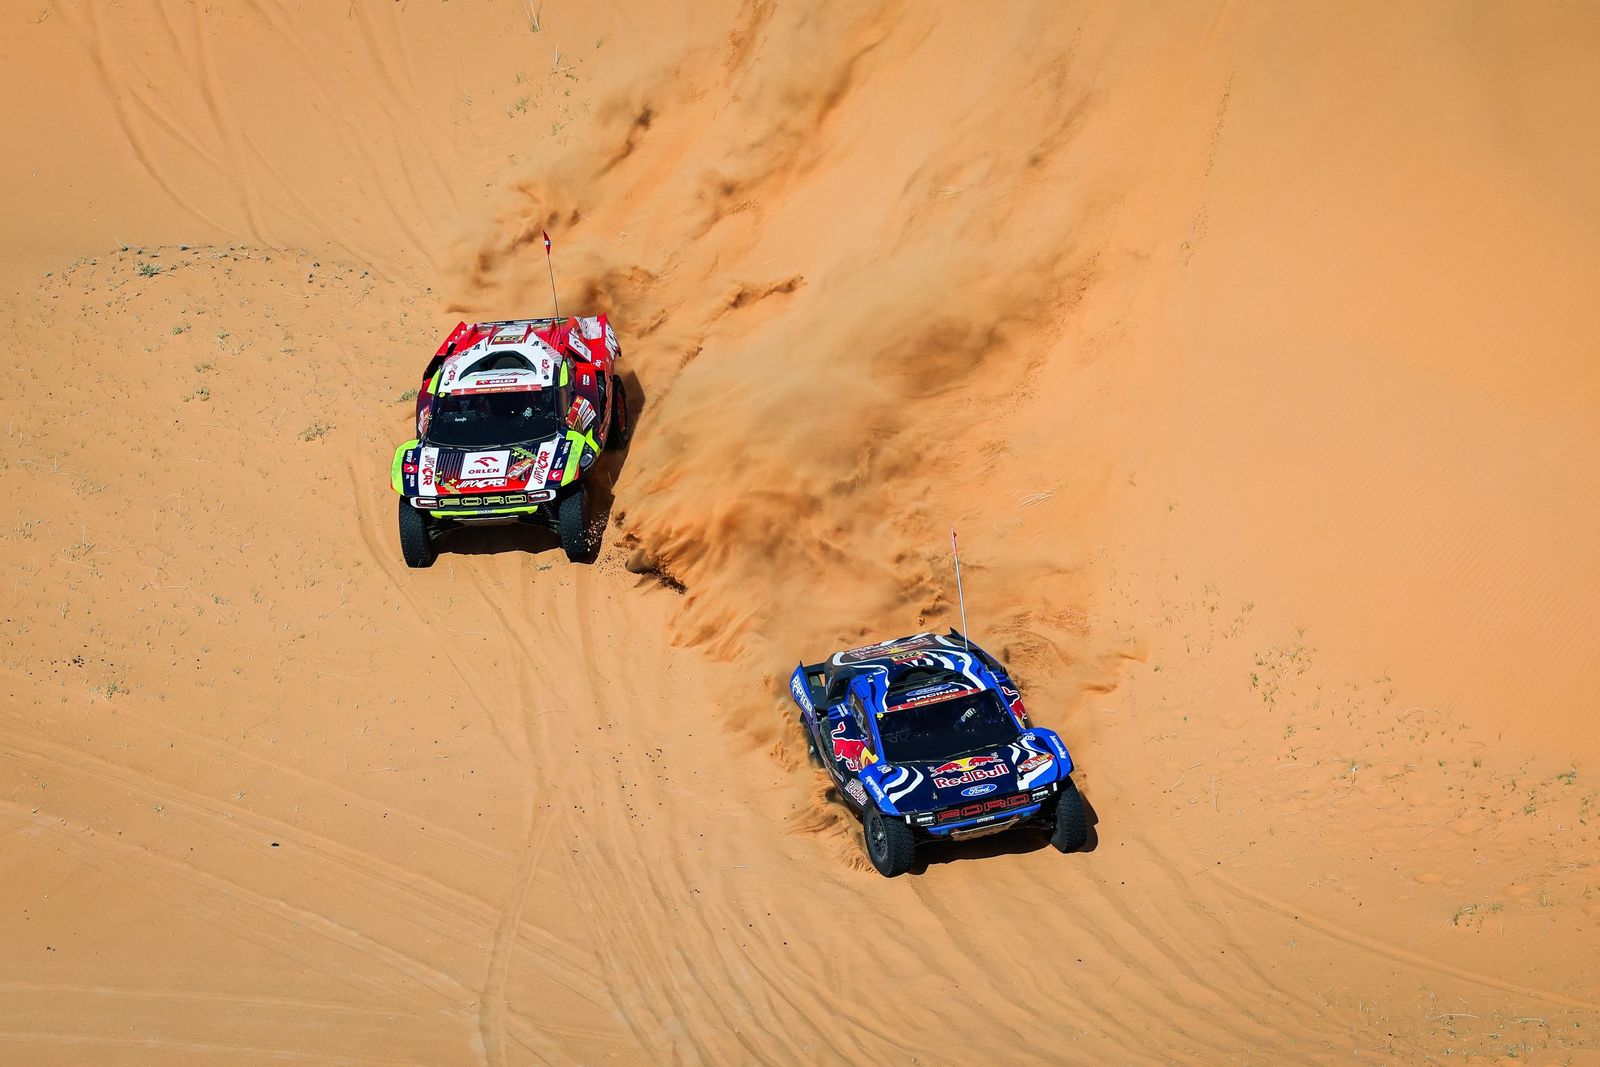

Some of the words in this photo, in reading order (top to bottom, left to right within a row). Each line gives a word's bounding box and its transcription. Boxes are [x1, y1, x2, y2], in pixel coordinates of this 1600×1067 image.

[439, 494, 526, 507] FORD
[934, 772, 973, 789] Red
[972, 763, 1010, 781] Bull
[968, 785, 991, 795] Ford
[937, 793, 1030, 821] FORD
